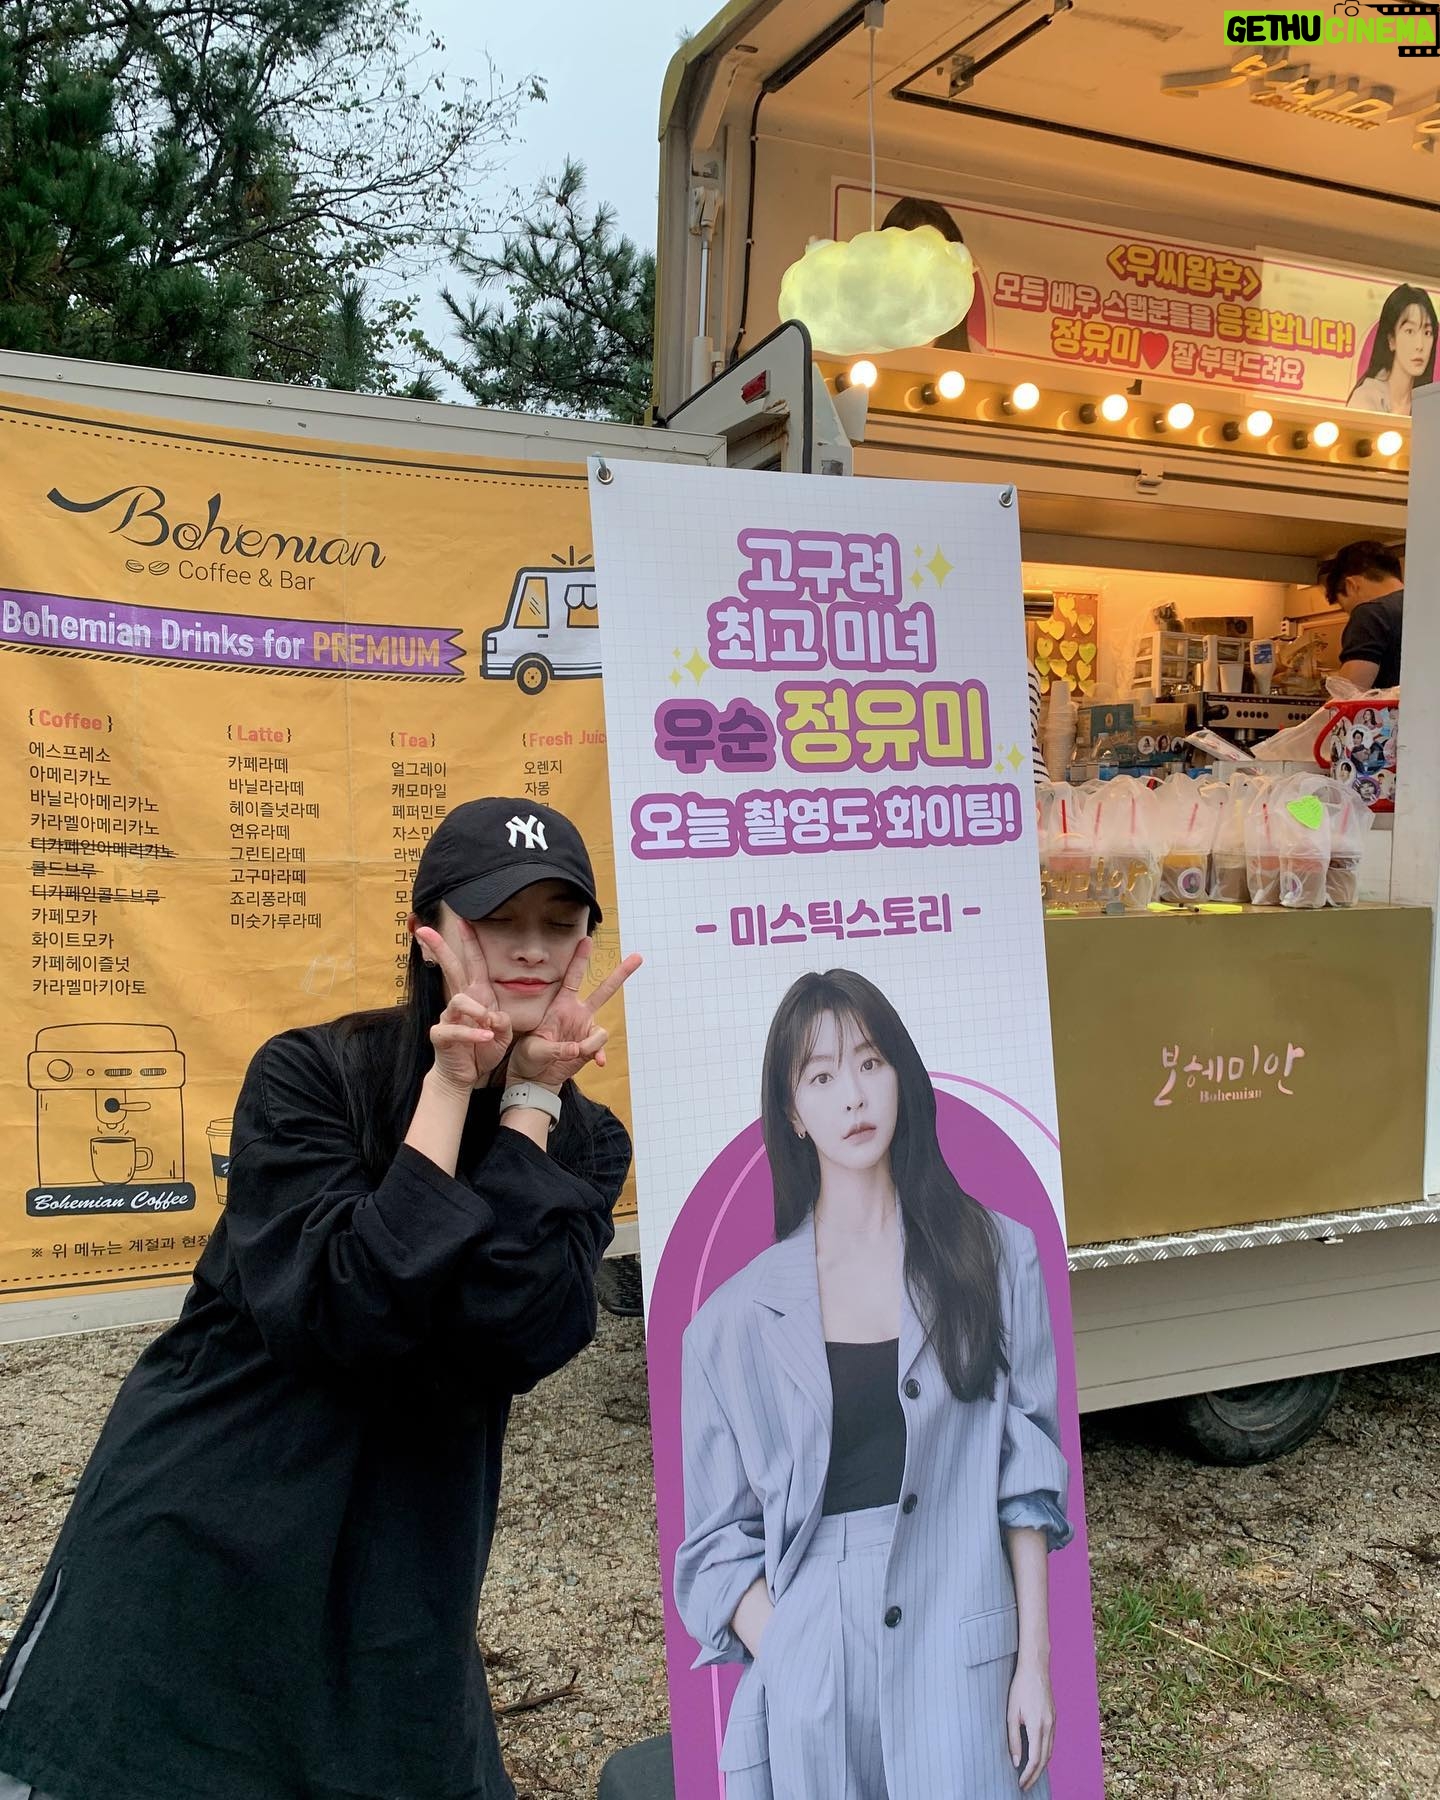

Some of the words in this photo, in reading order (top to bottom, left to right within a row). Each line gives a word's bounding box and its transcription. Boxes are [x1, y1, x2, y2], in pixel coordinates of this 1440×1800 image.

[995, 273, 1047, 309] 모든
[1051, 281, 1099, 315] 배우
[1103, 291, 1213, 335] 스탭분들을
[1217, 303, 1354, 355] 응원합니다!
[1052, 318, 1141, 364] 정유미
[1172, 341, 1197, 373] 잘
[1200, 346, 1302, 387] 부탁드려요
[47, 484, 387, 569] Bohemian
[178, 559, 252, 586] Coffee
[258, 569, 273, 588] &
[279, 570, 316, 591] Bar
[742, 532, 898, 599] 고구려
[1, 601, 154, 649] Bohemian
[160, 617, 255, 660] Drinks
[261, 629, 305, 662] for
[312, 630, 441, 668] PREMIUM
[712, 602, 822, 667] 최고
[831, 605, 933, 668] 미녀
[659, 703, 772, 769] 우순
[779, 683, 988, 767] 정유미
[28, 741, 111, 763] 에스프레소
[228, 755, 289, 773] 카페라떼
[391, 761, 447, 778] 얼그레이
[523, 759, 562, 775] 오렌지
[29, 765, 112, 787] 아메리카노
[228, 778, 304, 796] 바닐라라떼
[391, 783, 447, 799] 캐모마일
[524, 781, 550, 796] 자몽
[30, 788, 160, 813] 바닐라아메리카노
[229, 801, 320, 819] 헤이즐넛라떼
[391, 804, 447, 820] 페퍼민트
[635, 796, 735, 855] 오늘
[740, 792, 875, 851] 촬영도
[883, 787, 1019, 844] 화이팅!
[30, 812, 160, 836] 카라멜아메리카노
[229, 823, 290, 840] 연유라떼
[392, 825, 434, 842] 자스민
[504, 814, 549, 851] NY
[229, 846, 306, 863] 그린티라떼
[393, 847, 425, 862] 라벤
[229, 868, 306, 885] 고구마라떼
[31, 884, 160, 905] 디카페인콜드브루
[230, 891, 306, 907] 죠리퐁라떼
[31, 907, 98, 926] 카페모카
[230, 913, 322, 929] 미숫가루라떼
[729, 893, 953, 946] 미스틱스토리
[31, 931, 114, 949] 화이트모카
[31, 955, 130, 973] 카페헤이즐넛
[32, 978, 147, 996] 카라멜마키아토
[1153, 1042, 1305, 1107] 보헤미안
[1200, 1086, 1262, 1103] Bohemian
[34, 1194, 125, 1211] Bohemian
[130, 1190, 189, 1210] Coffee
[51, 1242, 68, 1259] 위
[74, 1240, 122, 1257] 메뉴는
[128, 1234, 176, 1253] 계절과
